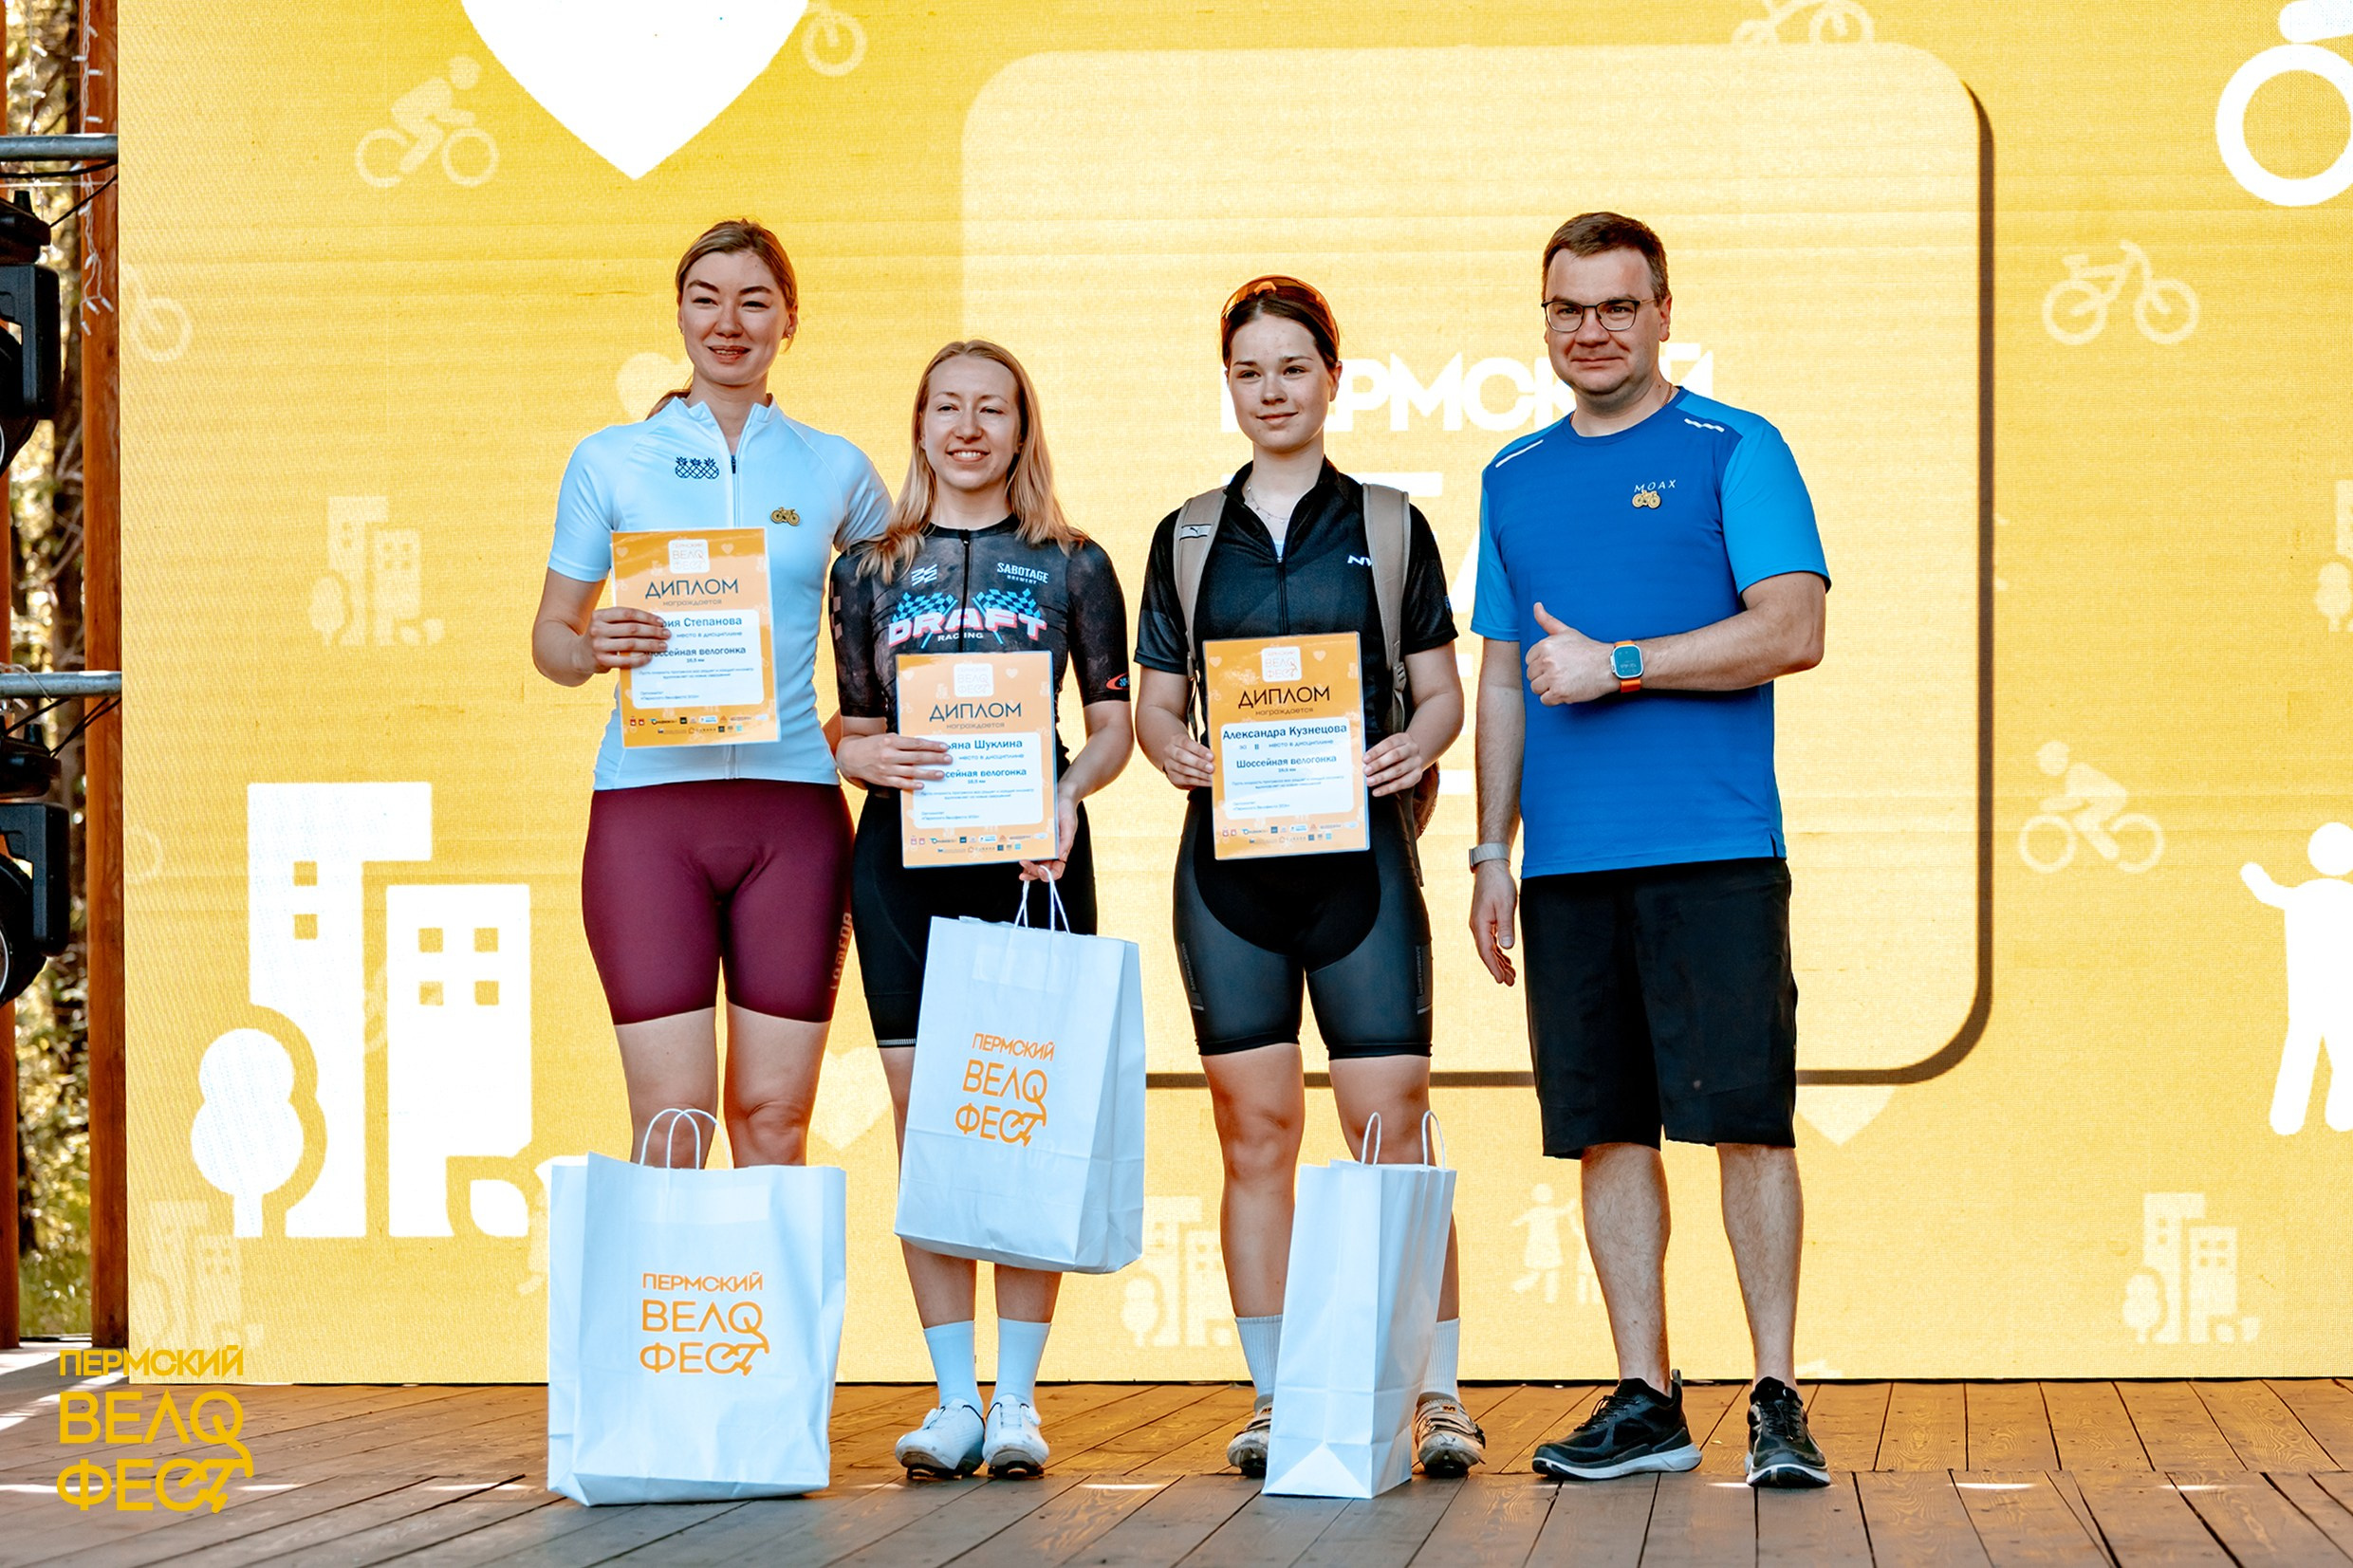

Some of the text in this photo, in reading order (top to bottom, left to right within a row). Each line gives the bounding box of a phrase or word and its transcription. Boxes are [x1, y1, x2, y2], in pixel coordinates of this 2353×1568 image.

[1634, 479, 1677, 493] MOAX
[997, 562, 1049, 584] SABOTAGE
[644, 578, 739, 600] ДИПЛОМ
[662, 599, 722, 607] награждается
[662, 617, 743, 628] рия Степанова
[888, 607, 1047, 647] DRAFT
[937, 632, 984, 642] RACING
[649, 646, 747, 657] оссейная велогонка
[1238, 685, 1330, 709] ДИПЛОМ
[929, 702, 1022, 722] ДИПЛОМ
[1255, 707, 1314, 716] награждается
[1222, 724, 1347, 740] Александра Кузнецова
[973, 739, 1023, 750] Шуклина
[1294, 739, 1334, 747] дисциплине
[1236, 755, 1337, 768] Шоссейная велогонка
[945, 768, 1028, 779] сейная велогонка
[972, 1032, 1056, 1062] ПЕРМСКИЙ
[962, 1059, 1048, 1109] ВЕЛО
[954, 1102, 1047, 1147] ФЕСТ
[642, 1271, 764, 1293] ПЕРМСКИЙ
[641, 1299, 768, 1341] ВЕЛО
[639, 1341, 766, 1376] ФЕСТ
